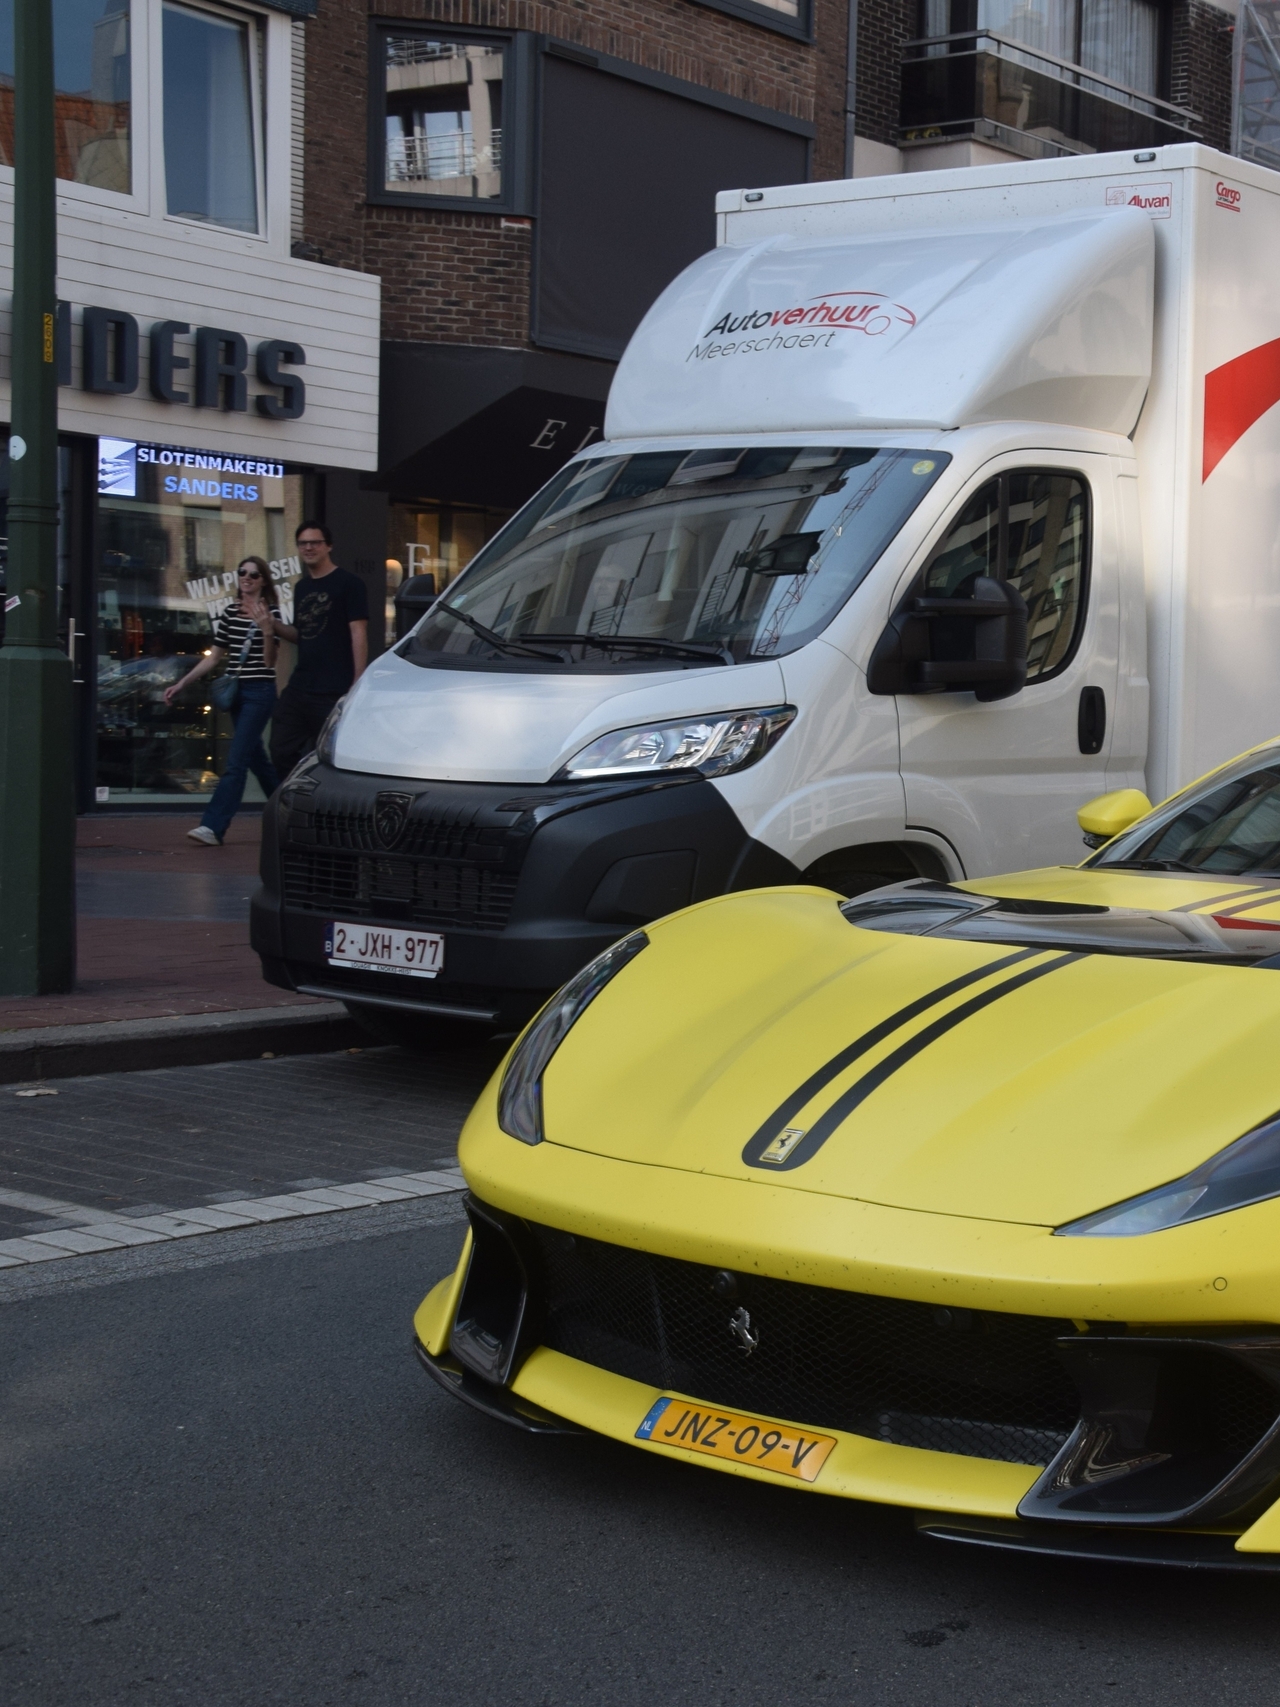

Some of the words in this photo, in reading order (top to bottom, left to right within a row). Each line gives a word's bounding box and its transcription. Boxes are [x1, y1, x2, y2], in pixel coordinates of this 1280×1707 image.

[1127, 195, 1170, 209] Aluvan
[1216, 181, 1241, 204] Cargo
[704, 302, 880, 339] Autoverhuur
[45, 314, 53, 361] 2609
[685, 331, 836, 362] Meerschaert
[57, 300, 306, 419] DERS
[138, 448, 284, 479] SLOTENMAKERIJ
[165, 476, 259, 502] SANDERS
[186, 575, 220, 600] WIJ
[325, 941, 333, 953] B
[335, 928, 440, 965] 2-JXH-977
[641, 1421, 651, 1432] NL
[664, 1410, 819, 1469] JNZ-09-V
